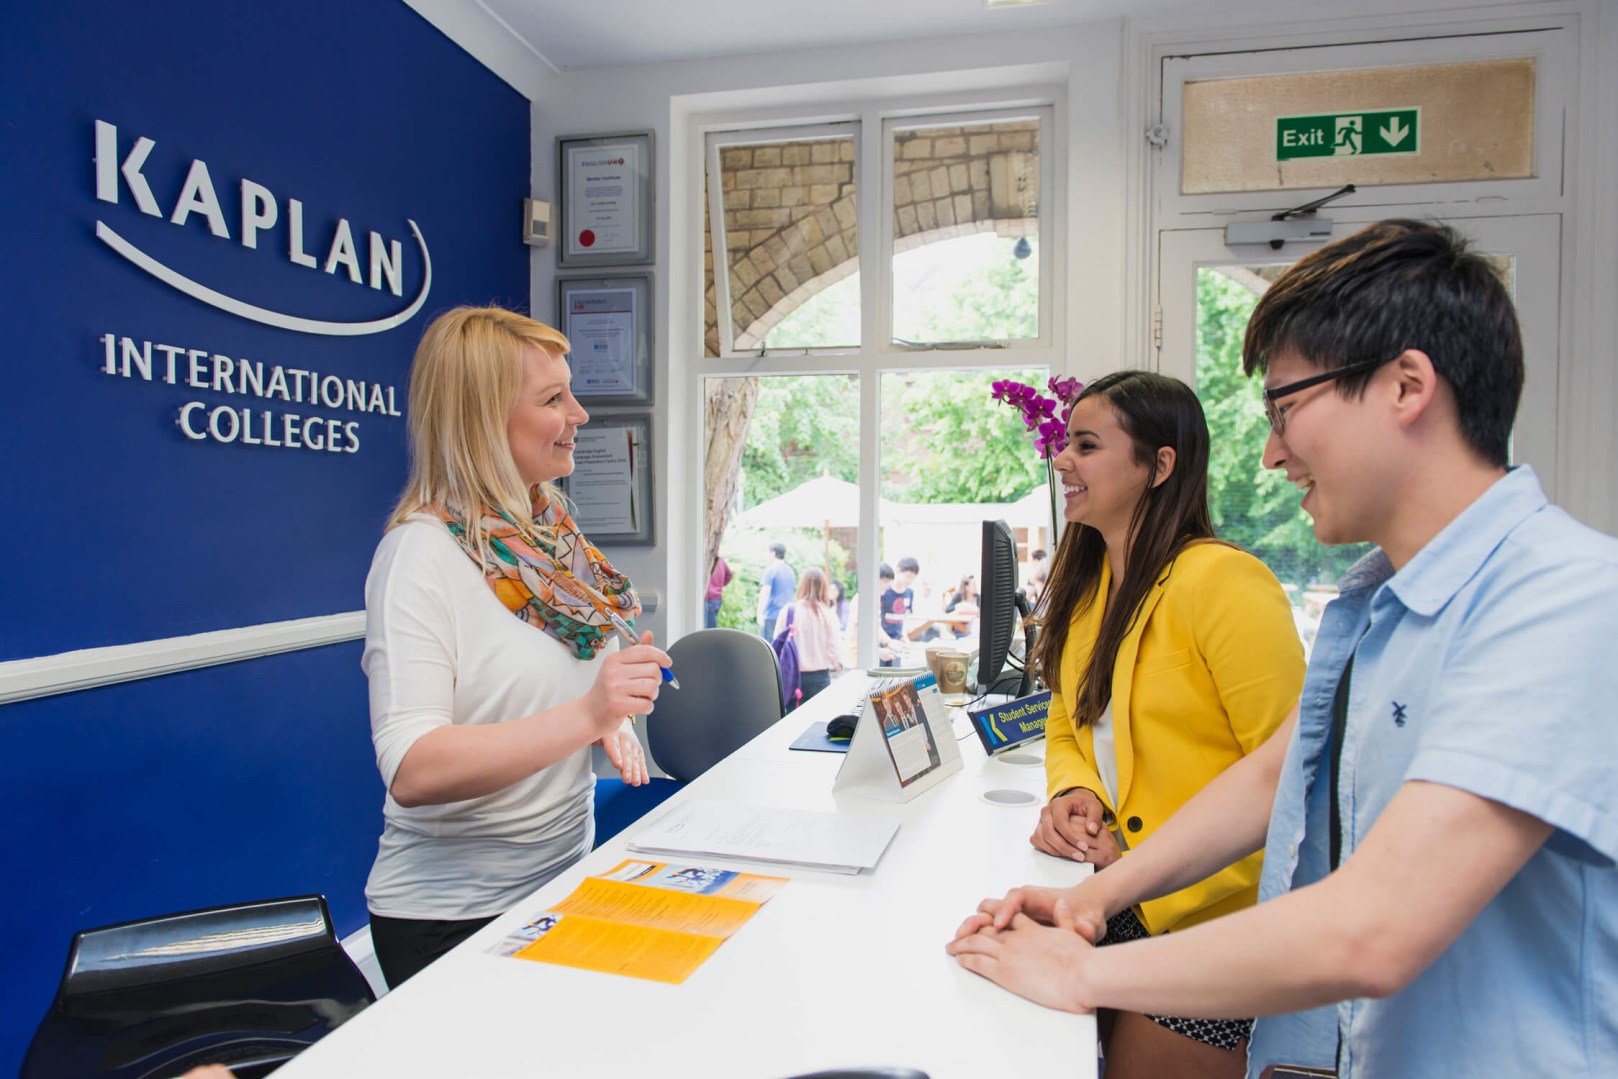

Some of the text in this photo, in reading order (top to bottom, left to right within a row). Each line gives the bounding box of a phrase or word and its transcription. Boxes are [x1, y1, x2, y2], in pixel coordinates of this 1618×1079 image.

[1282, 129, 1324, 147] Exit
[95, 119, 402, 297] KAPLAN
[104, 333, 401, 417] INTERNATIONAL
[179, 401, 360, 454] COLLEGES
[998, 706, 1027, 723] Student
